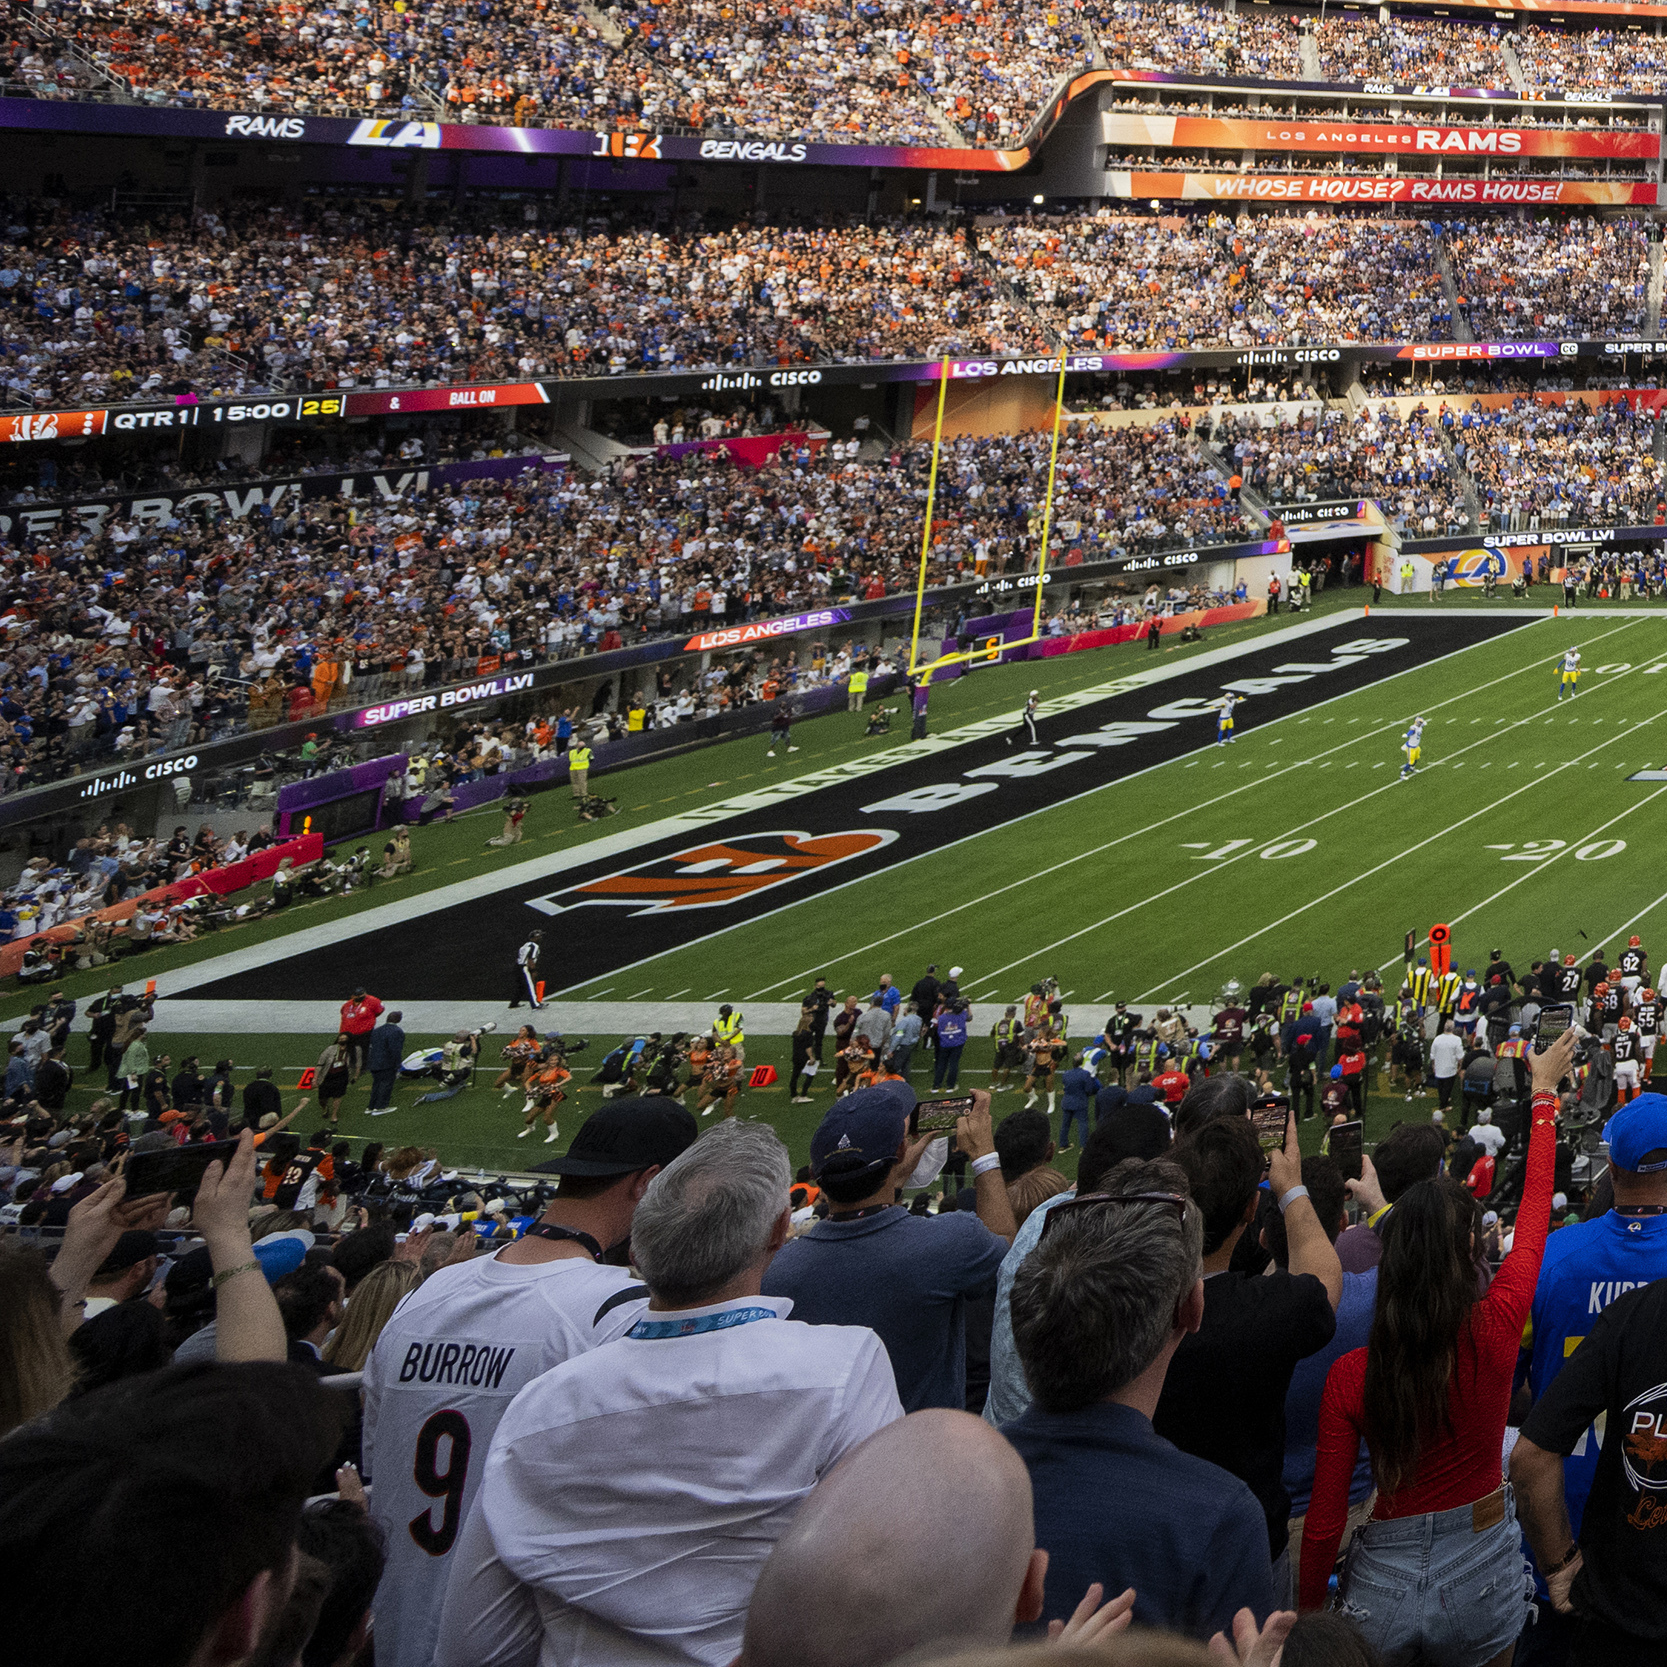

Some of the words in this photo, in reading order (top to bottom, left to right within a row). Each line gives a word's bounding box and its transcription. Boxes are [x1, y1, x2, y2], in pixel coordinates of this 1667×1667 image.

[225, 115, 306, 139] RAMS
[700, 139, 807, 163] BENGALS
[1266, 130, 1307, 142] LOS
[1316, 131, 1412, 145] ANGELES
[1415, 129, 1522, 153] RAMS
[1214, 177, 1304, 199] WHOSE
[1308, 178, 1406, 200] HOUSE?
[1411, 182, 1477, 201] RAMS
[1482, 181, 1564, 202] HOUSE!
[1294, 349, 1340, 362] CISCO
[1413, 346, 1483, 359] SUPER
[1488, 344, 1546, 357] BOWL
[769, 371, 822, 387] CISCO
[212, 402, 290, 422] 15:00
[302, 399, 340, 417] 25
[1483, 534, 1539, 548] SUPER
[1541, 530, 1592, 545] BOWL
[1592, 529, 1616, 542] LVI
[1163, 552, 1200, 566] CISCO
[1016, 573, 1052, 589] CISCO
[699, 628, 743, 650] LOS
[742, 610, 833, 641] ANGELES
[364, 694, 438, 726] SUPER
[440, 681, 504, 708] BOWL
[503, 672, 535, 693] LVI
[860, 631, 1412, 815] BENGALS
[144, 754, 199, 780] CISCO
[1192, 838, 1318, 860] 10
[1499, 839, 1627, 861] 20
[1622, 957, 1641, 973] 92
[1637, 1011, 1655, 1028] 55
[1615, 1039, 1633, 1057] 57
[399, 1341, 515, 1390] BURROW
[408, 1408, 472, 1557] 9
